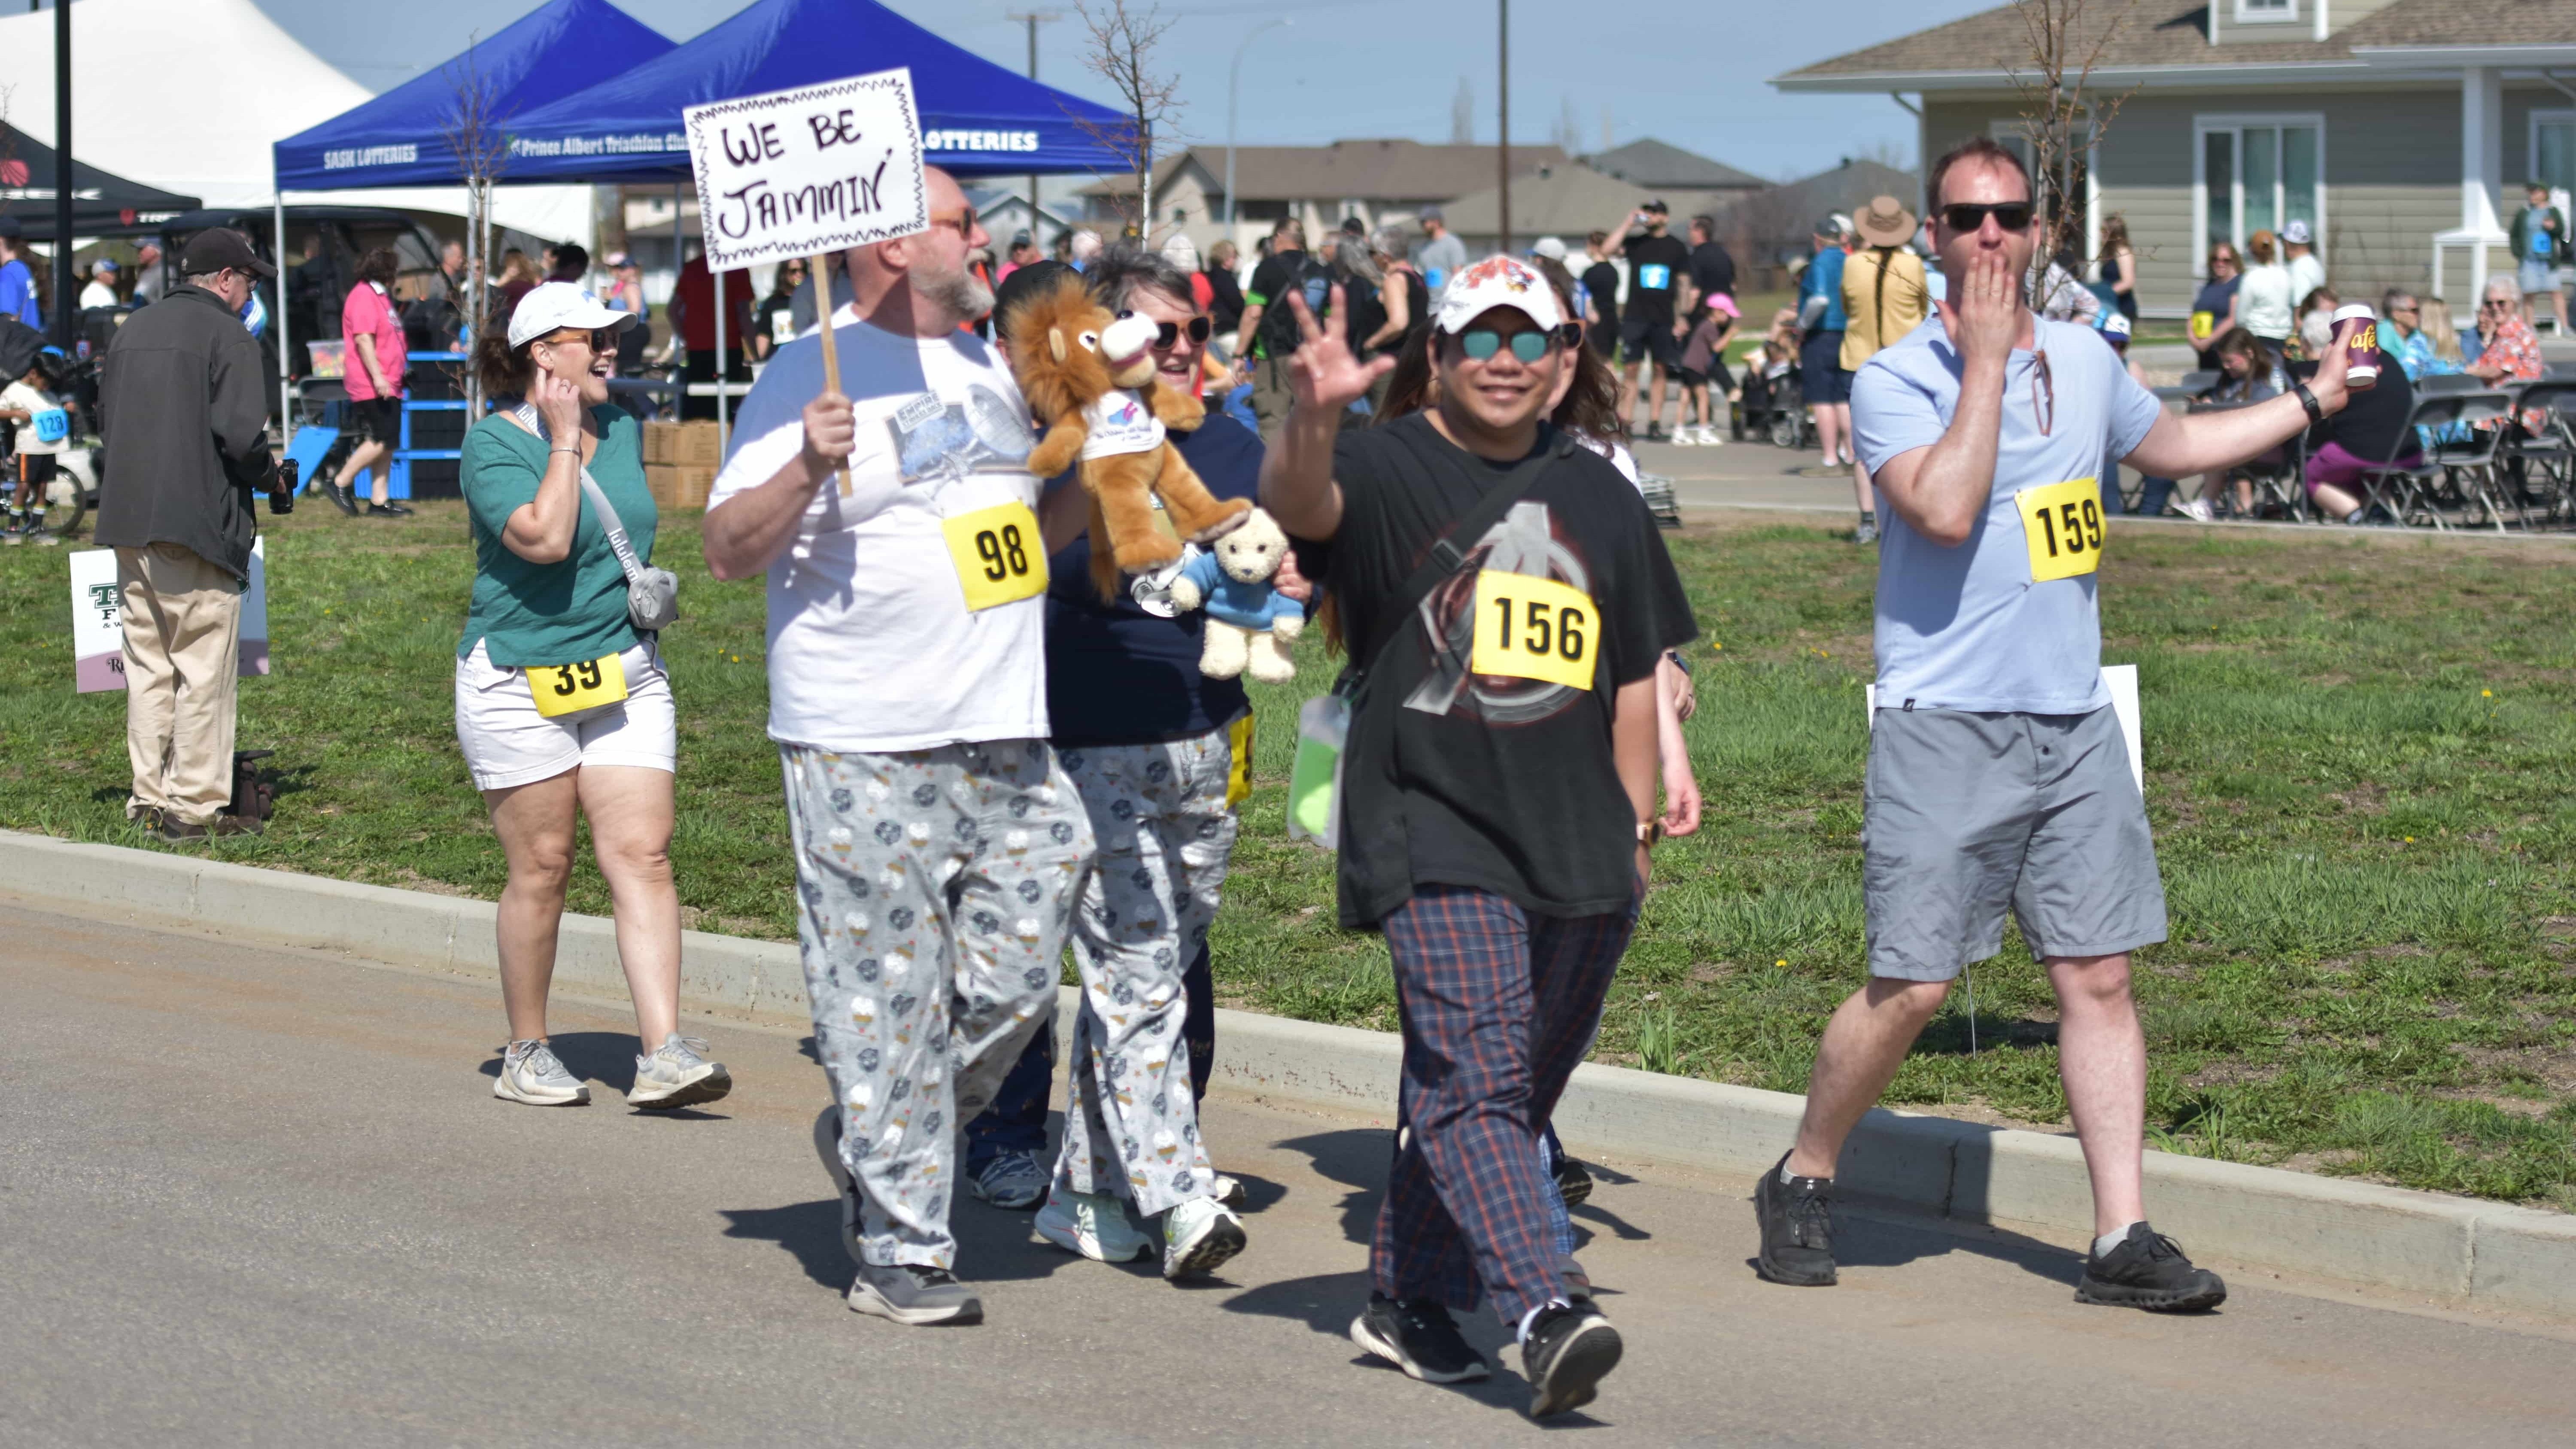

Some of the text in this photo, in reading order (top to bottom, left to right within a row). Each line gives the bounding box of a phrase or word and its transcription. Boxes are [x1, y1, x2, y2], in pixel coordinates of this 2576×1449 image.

[521, 132, 689, 157] Prince Albert Triathlon Clu
[721, 109, 861, 167] WE BE
[920, 130, 1039, 152] OTTERIES
[357, 144, 418, 166] LOTTERIES
[0, 188, 102, 200] REK
[2351, 325, 2376, 353] afé
[2036, 499, 2101, 558] 159
[975, 523, 1029, 583] 98
[1494, 597, 1585, 661] 156
[550, 659, 602, 696] 39
